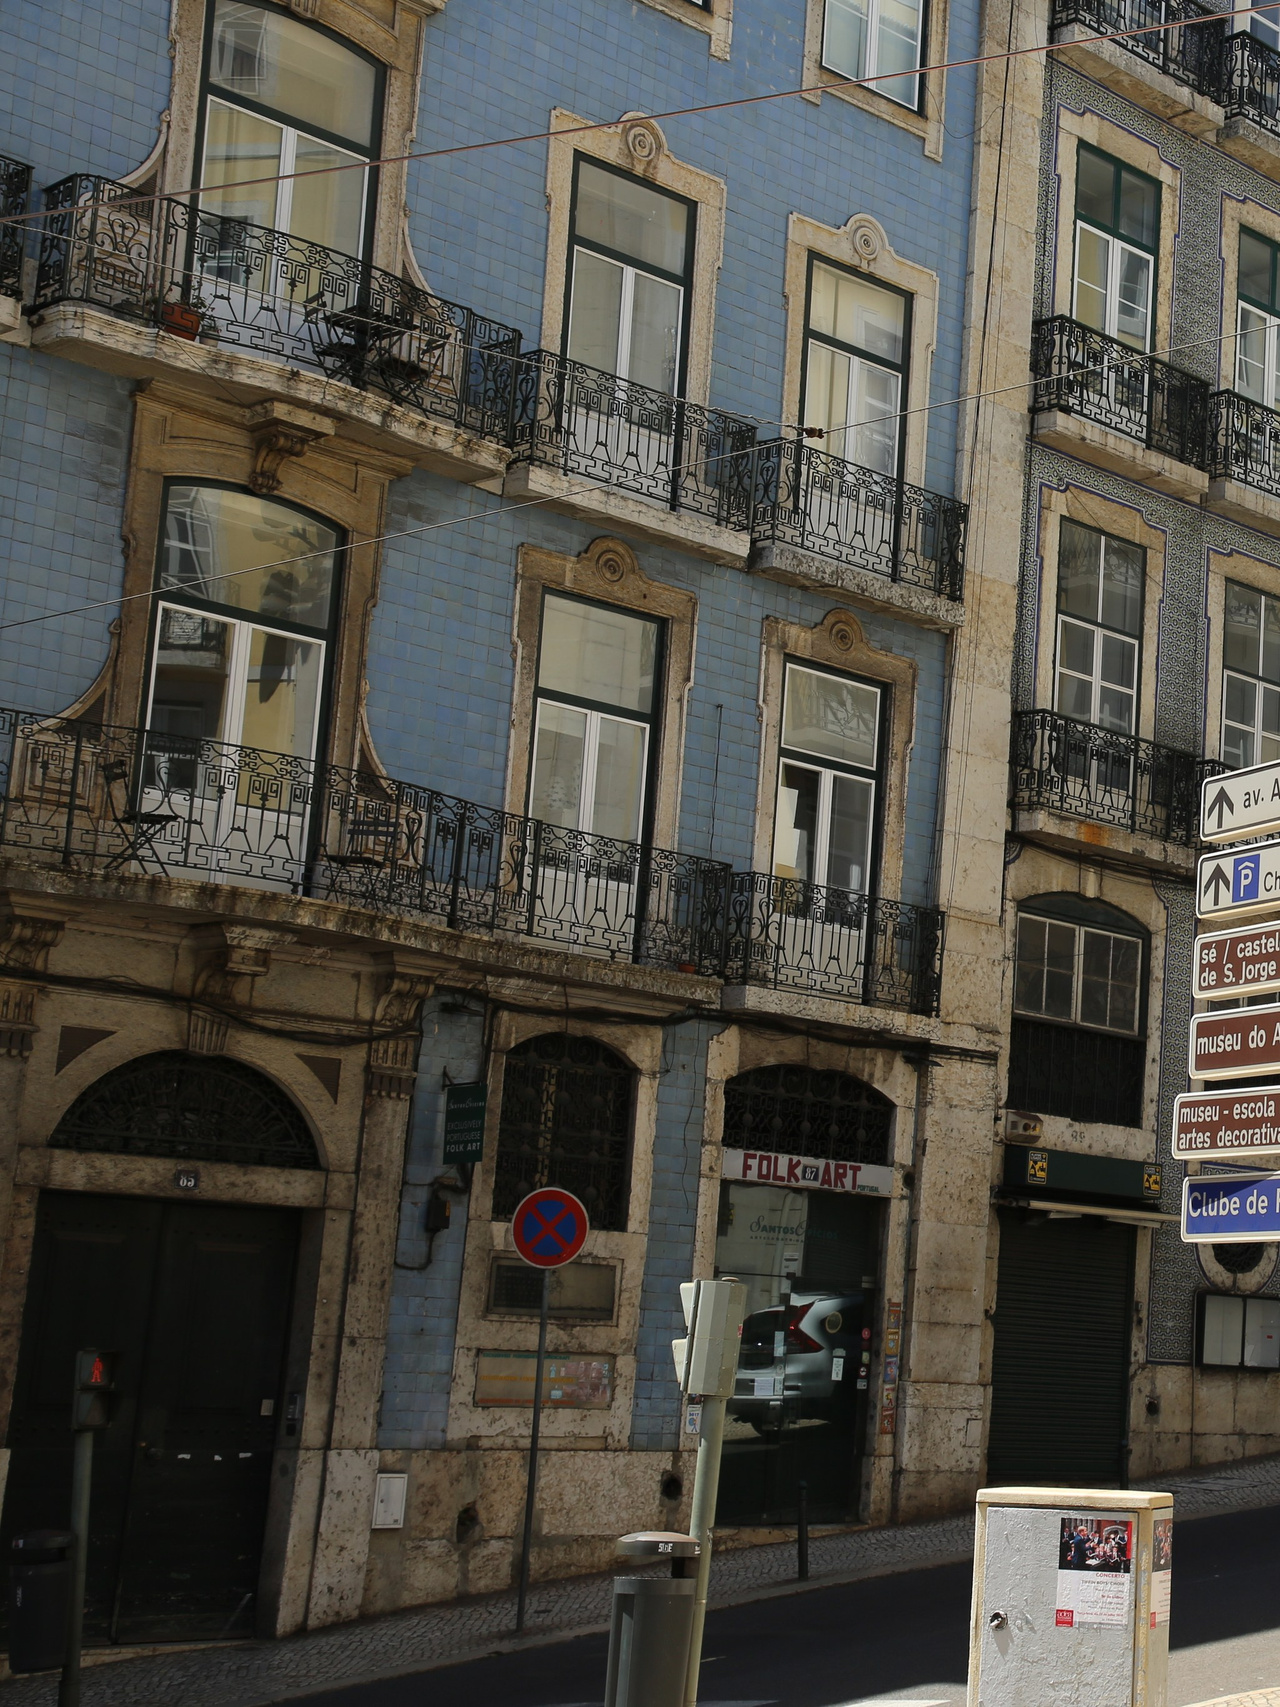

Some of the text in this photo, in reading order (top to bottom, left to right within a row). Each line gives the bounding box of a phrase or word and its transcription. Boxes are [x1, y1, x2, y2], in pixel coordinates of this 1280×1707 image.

[1243, 787, 1264, 809] av.
[1201, 943, 1217, 965] sé
[1200, 959, 1277, 987] de S. Jorge
[1197, 1032, 1242, 1055] museu
[1248, 1024, 1266, 1048] do
[1179, 1104, 1220, 1124] museu
[1233, 1096, 1275, 1120] escola
[446, 1131, 481, 1141] PORTUGUESE
[1179, 1128, 1211, 1150] artes
[446, 1142, 481, 1153] FOLK ART
[742, 1152, 862, 1191] FOLK ART
[805, 1167, 817, 1181] 87
[857, 1184, 880, 1193] PORTUGAL
[1188, 1190, 1240, 1218] Clube
[1246, 1189, 1268, 1215] de
